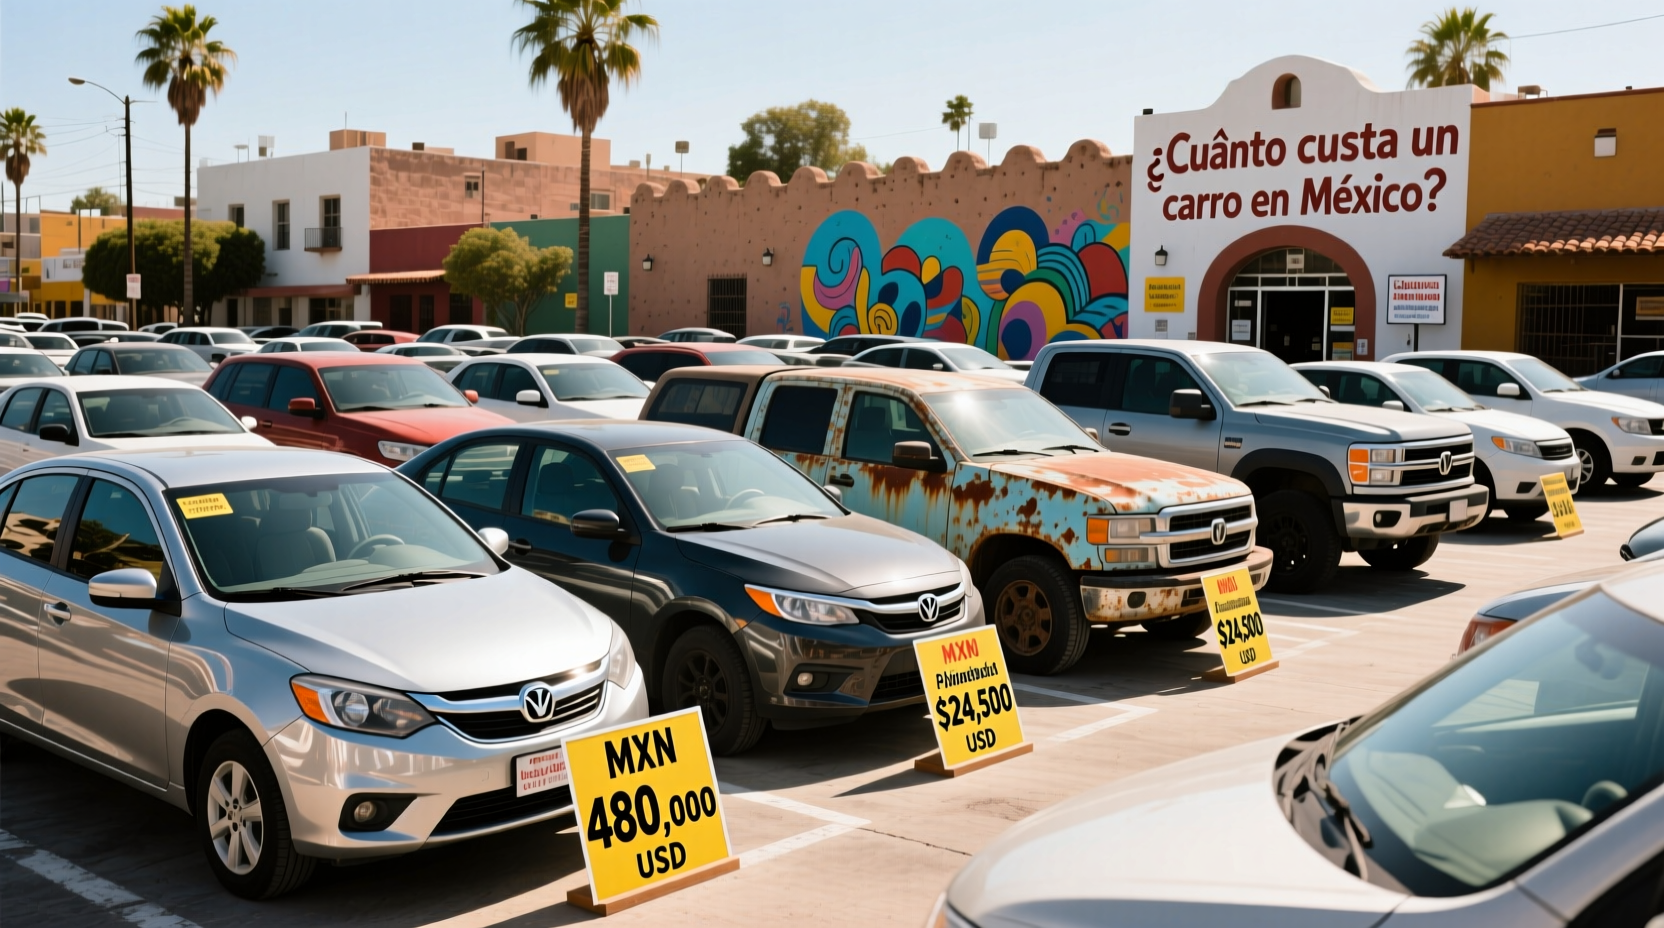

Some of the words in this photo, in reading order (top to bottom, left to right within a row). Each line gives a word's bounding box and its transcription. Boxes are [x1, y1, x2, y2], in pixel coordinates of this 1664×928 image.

[1297, 123, 1398, 164] custa
[1411, 124, 1459, 157] un
[1162, 191, 1243, 221] carro
[1251, 189, 1289, 218] en
[1300, 167, 1448, 216] México?
[935, 683, 1013, 732] $24,500
[604, 727, 678, 779] MXN
[966, 728, 997, 753] USD
[587, 784, 717, 849] 480,000
[636, 842, 687, 878] USD
